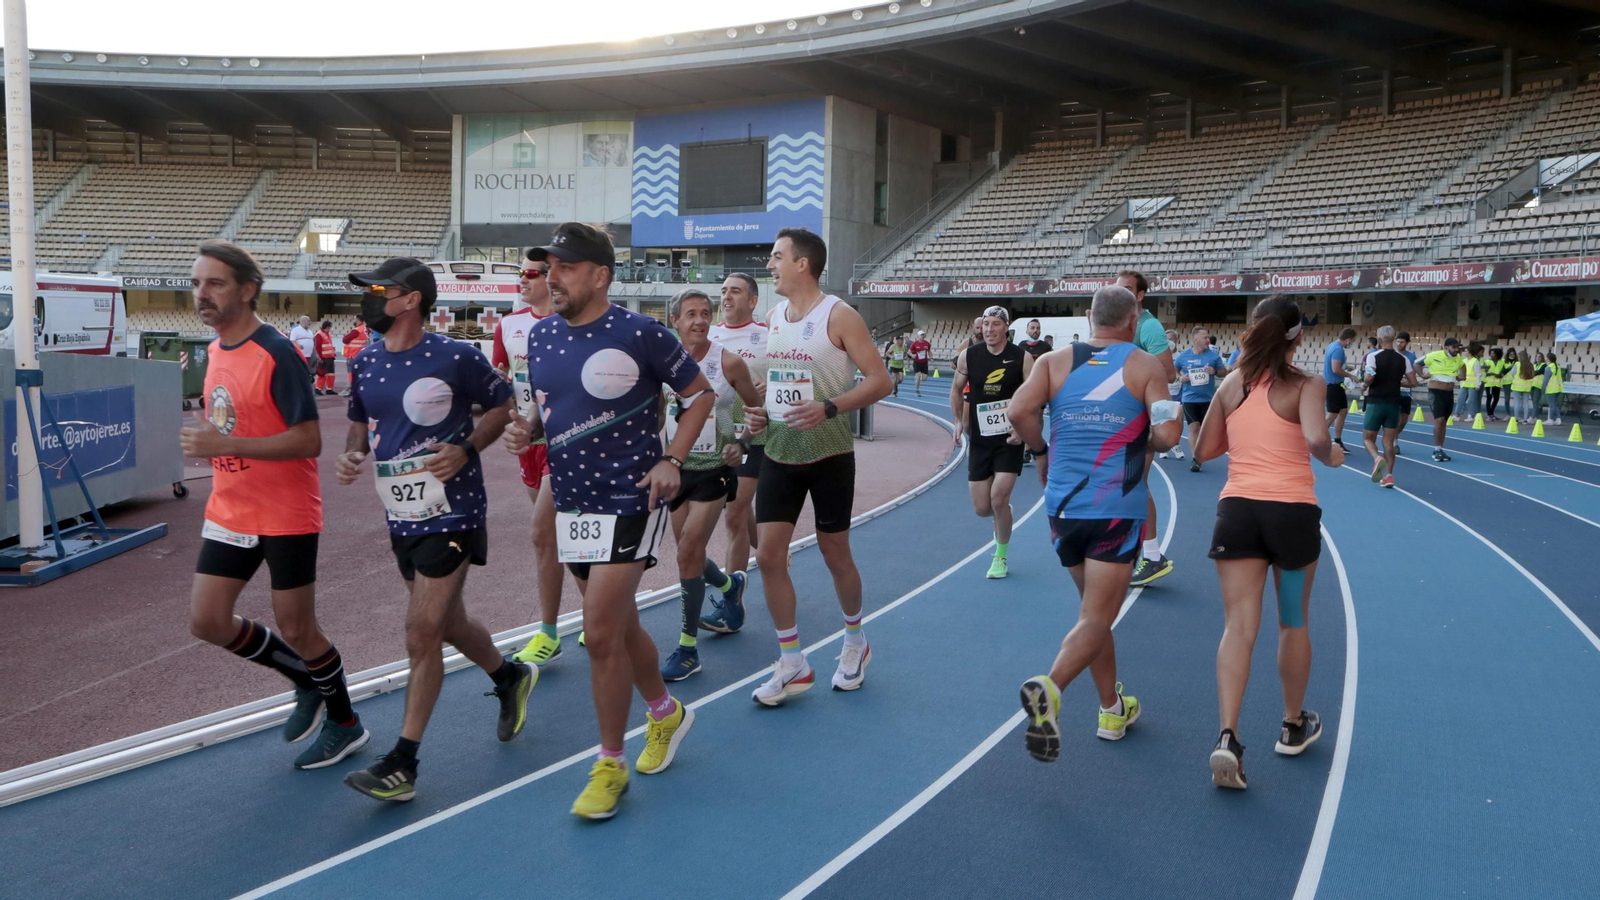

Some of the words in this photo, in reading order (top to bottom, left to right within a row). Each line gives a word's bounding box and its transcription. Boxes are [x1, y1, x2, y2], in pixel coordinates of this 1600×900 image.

[474, 173, 576, 190] ROCHDALE
[695, 224, 736, 233] Ayuntamiento
[744, 223, 760, 232] Jerez
[1393, 268, 1450, 285] Cruzcampo
[1532, 261, 1599, 280] Cruzcampo
[124, 278, 161, 287] CALIDAD
[1060, 279, 1102, 292] Cruzcampo
[1161, 277, 1208, 291] Cruzcampo
[1272, 274, 1322, 288] Cruzcampo
[437, 284, 499, 293] AMBULANCIA
[870, 283, 910, 294] Cruzcampo
[963, 282, 1004, 293] Cruzcampo
[67, 333, 75, 344] Roja
[1194, 373, 1206, 381] 650
[775, 389, 802, 405] 830
[986, 413, 1006, 425] 621
[1102, 412, 1126, 424] Páez
[391, 481, 427, 502] 927
[570, 520, 601, 541] 883
